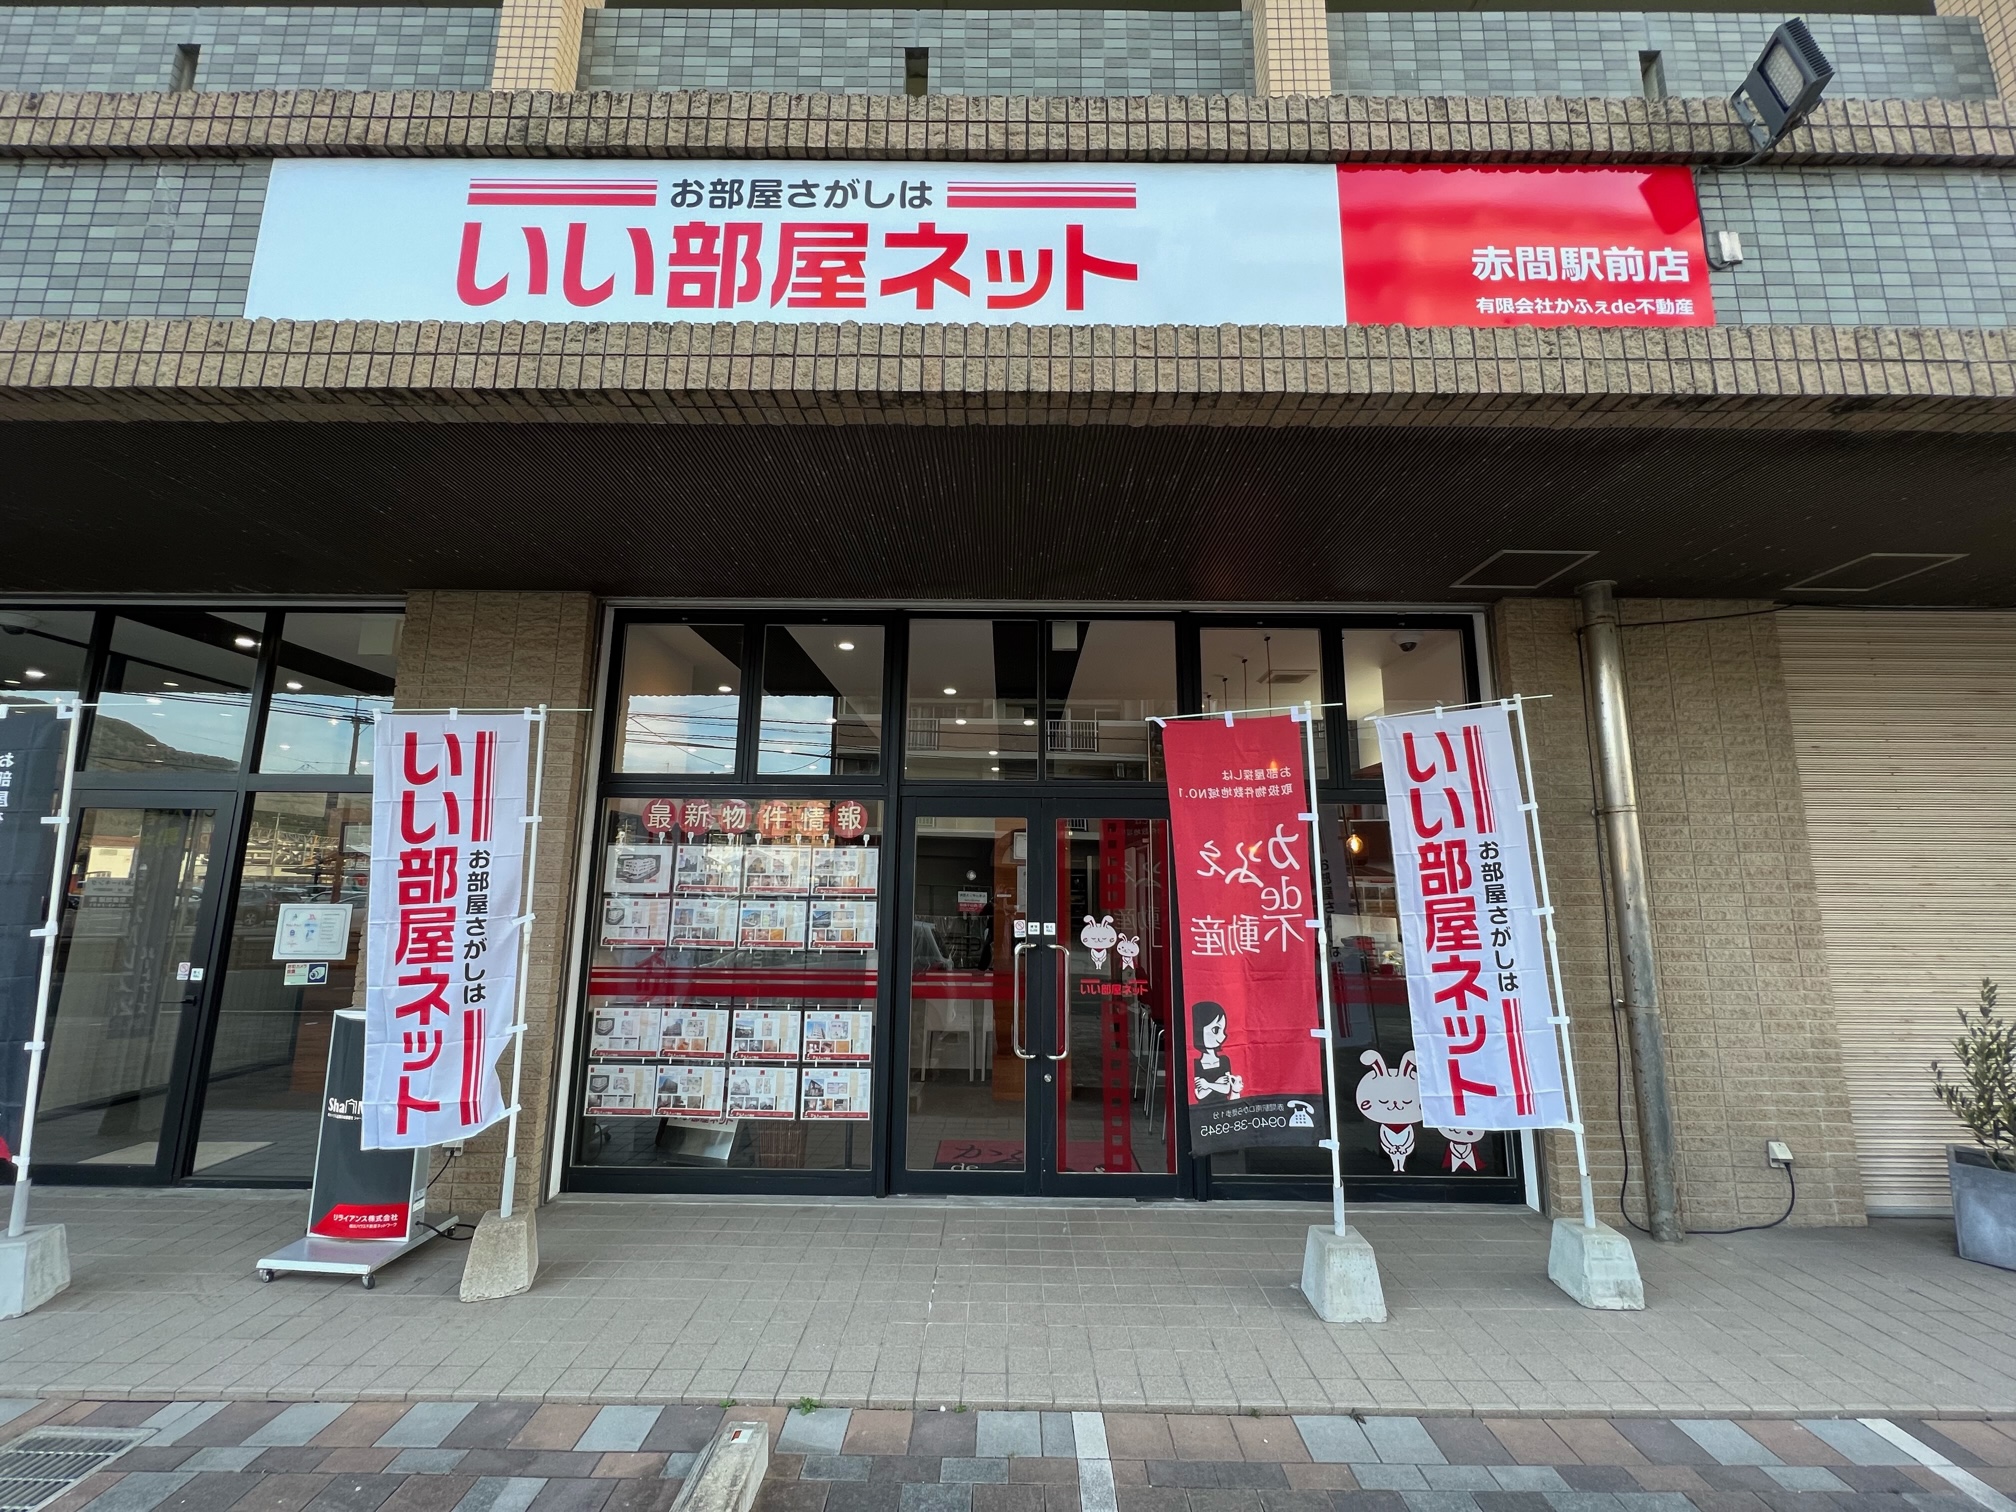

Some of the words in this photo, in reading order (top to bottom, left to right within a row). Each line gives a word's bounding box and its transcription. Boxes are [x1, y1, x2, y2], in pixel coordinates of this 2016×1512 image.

[671, 178, 933, 209] お部屋さがしは
[456, 221, 1139, 310] いい部屋ネット
[1471, 246, 1690, 283] 赤間駅前店
[1476, 297, 1695, 315] 有限会社かふぇde不動産
[648, 802, 862, 832] 最新物件情報
[395, 730, 462, 1136] いい部屋ネット
[462, 848, 491, 1005] お部屋さがしは
[1402, 731, 1497, 1117] いい部屋ネット
[1477, 840, 1519, 993] お部屋さがしは
[1080, 984, 1149, 996] いい部屋ネット
[333, 1213, 399, 1223] リライアンス株式会社
